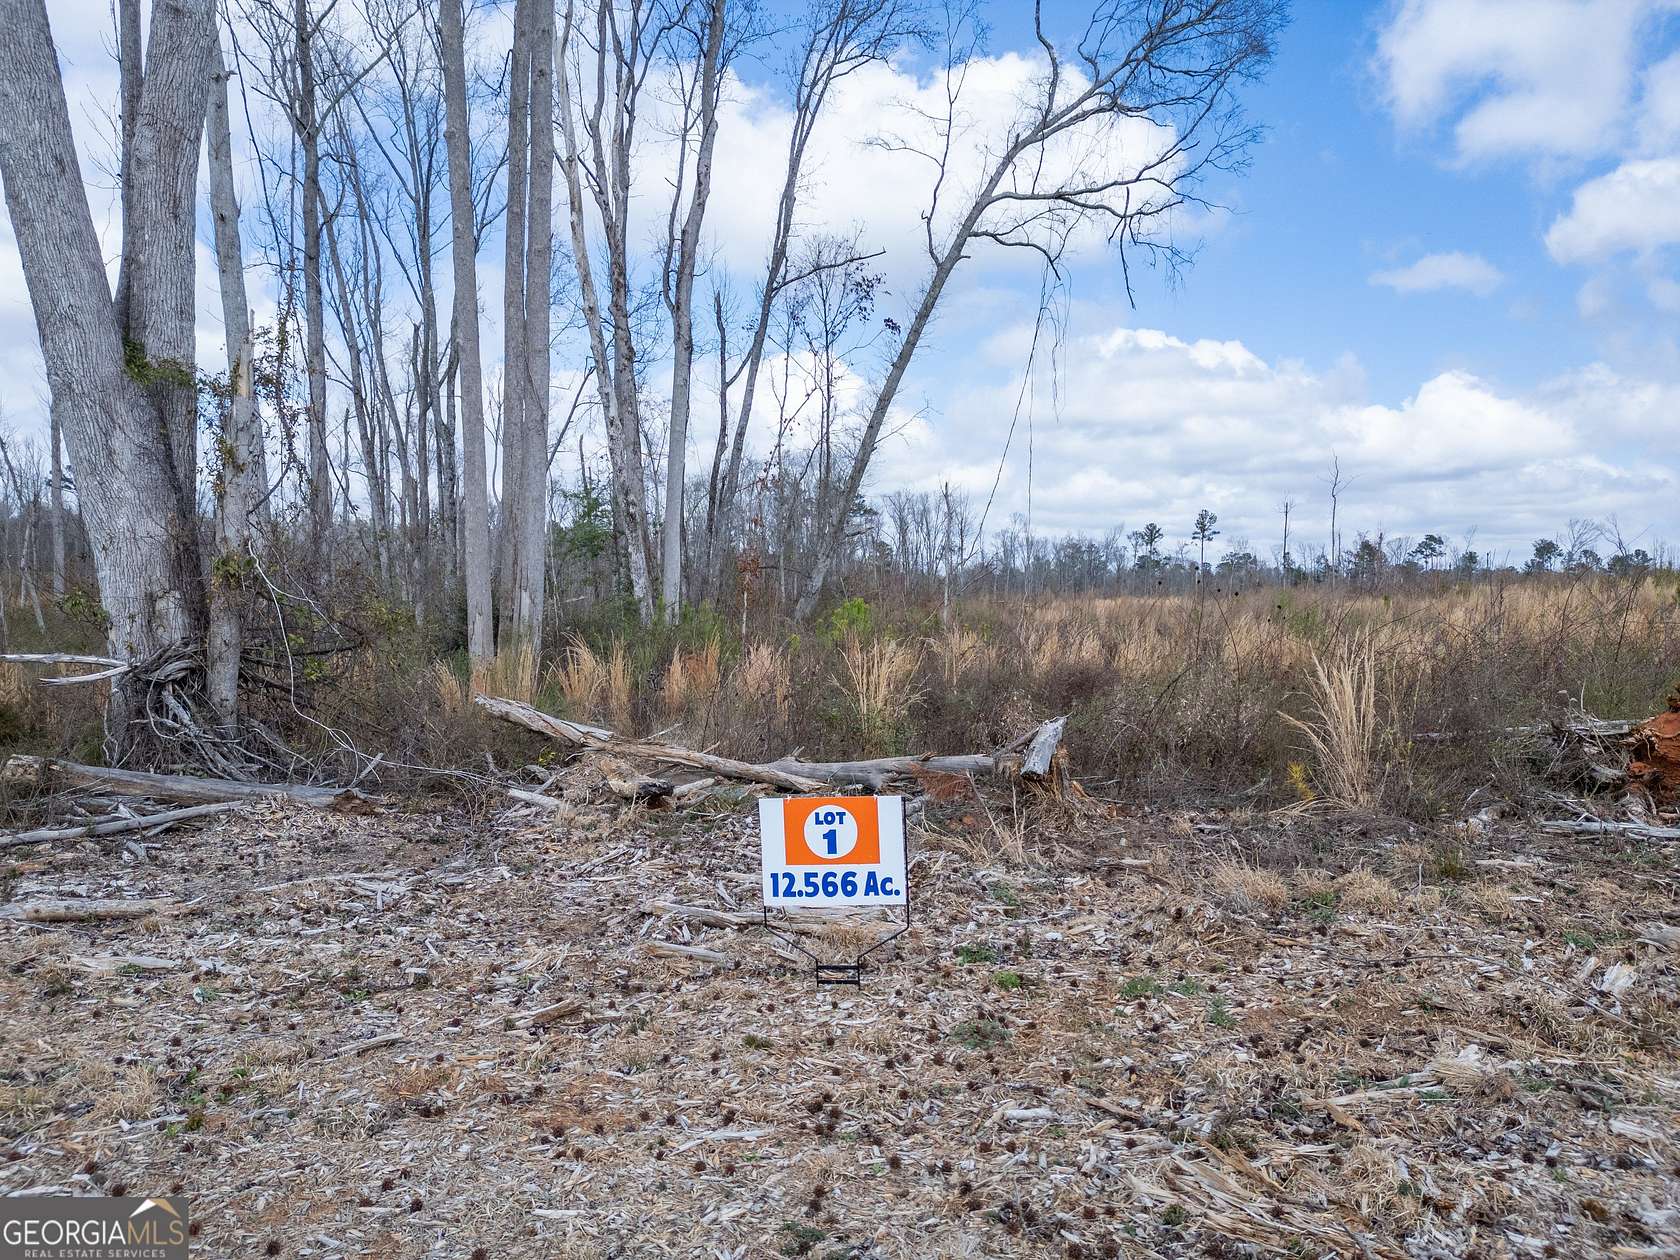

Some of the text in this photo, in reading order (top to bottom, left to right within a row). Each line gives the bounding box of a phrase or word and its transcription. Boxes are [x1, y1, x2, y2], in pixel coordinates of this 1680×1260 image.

[814, 811, 847, 826] LOT
[822, 829, 838, 855] 1
[770, 871, 901, 898] 12.566 Ac.
